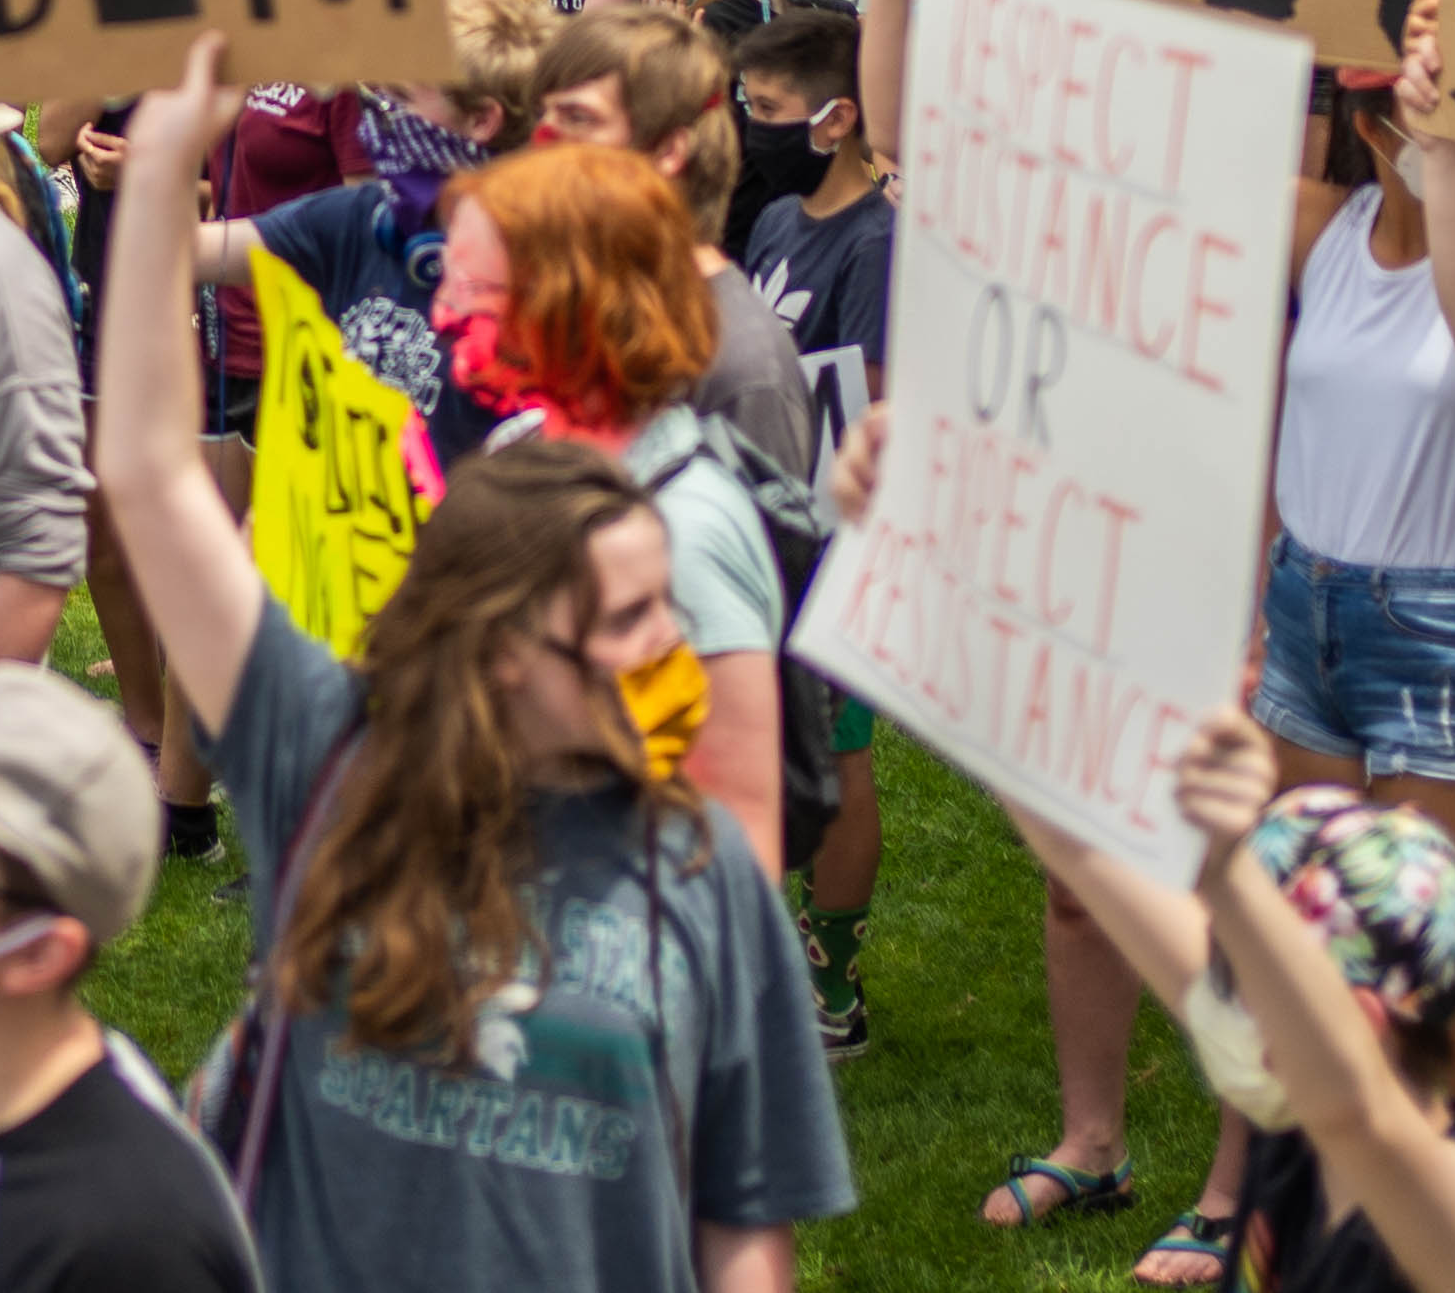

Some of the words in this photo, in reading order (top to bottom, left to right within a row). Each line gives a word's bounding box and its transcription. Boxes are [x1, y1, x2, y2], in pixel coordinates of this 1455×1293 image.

[965, 281, 1070, 446] OR
[923, 416, 1143, 661] EXPECT
[318, 1039, 638, 1183] SPARTANS
